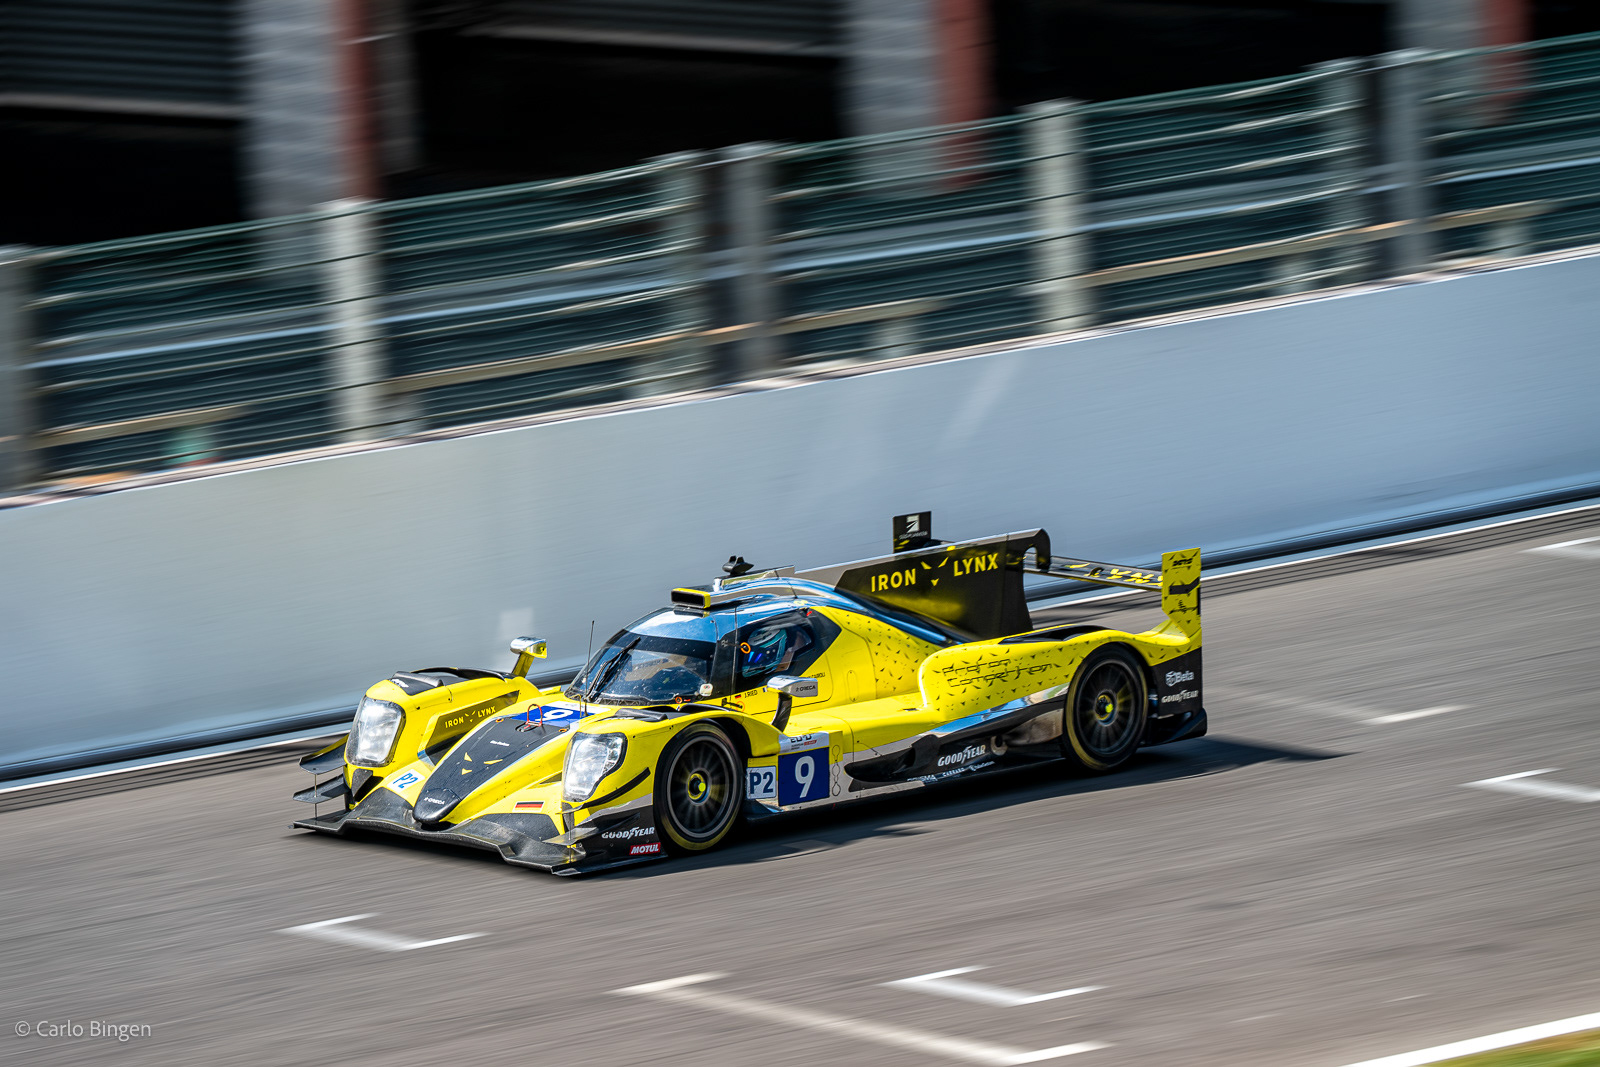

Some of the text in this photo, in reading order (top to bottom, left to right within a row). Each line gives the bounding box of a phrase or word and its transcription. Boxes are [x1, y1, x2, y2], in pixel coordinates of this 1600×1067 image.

[871, 552, 999, 592] IRON LYNX
[1176, 670, 1195, 682] Beta
[445, 706, 496, 728] IRON LYNX
[937, 744, 986, 767] GOODYEAR
[393, 773, 419, 789] P2
[749, 771, 774, 794] P2
[795, 755, 815, 798] 9
[602, 826, 655, 840] GOODYEAR
[631, 845, 659, 854] MOTUL
